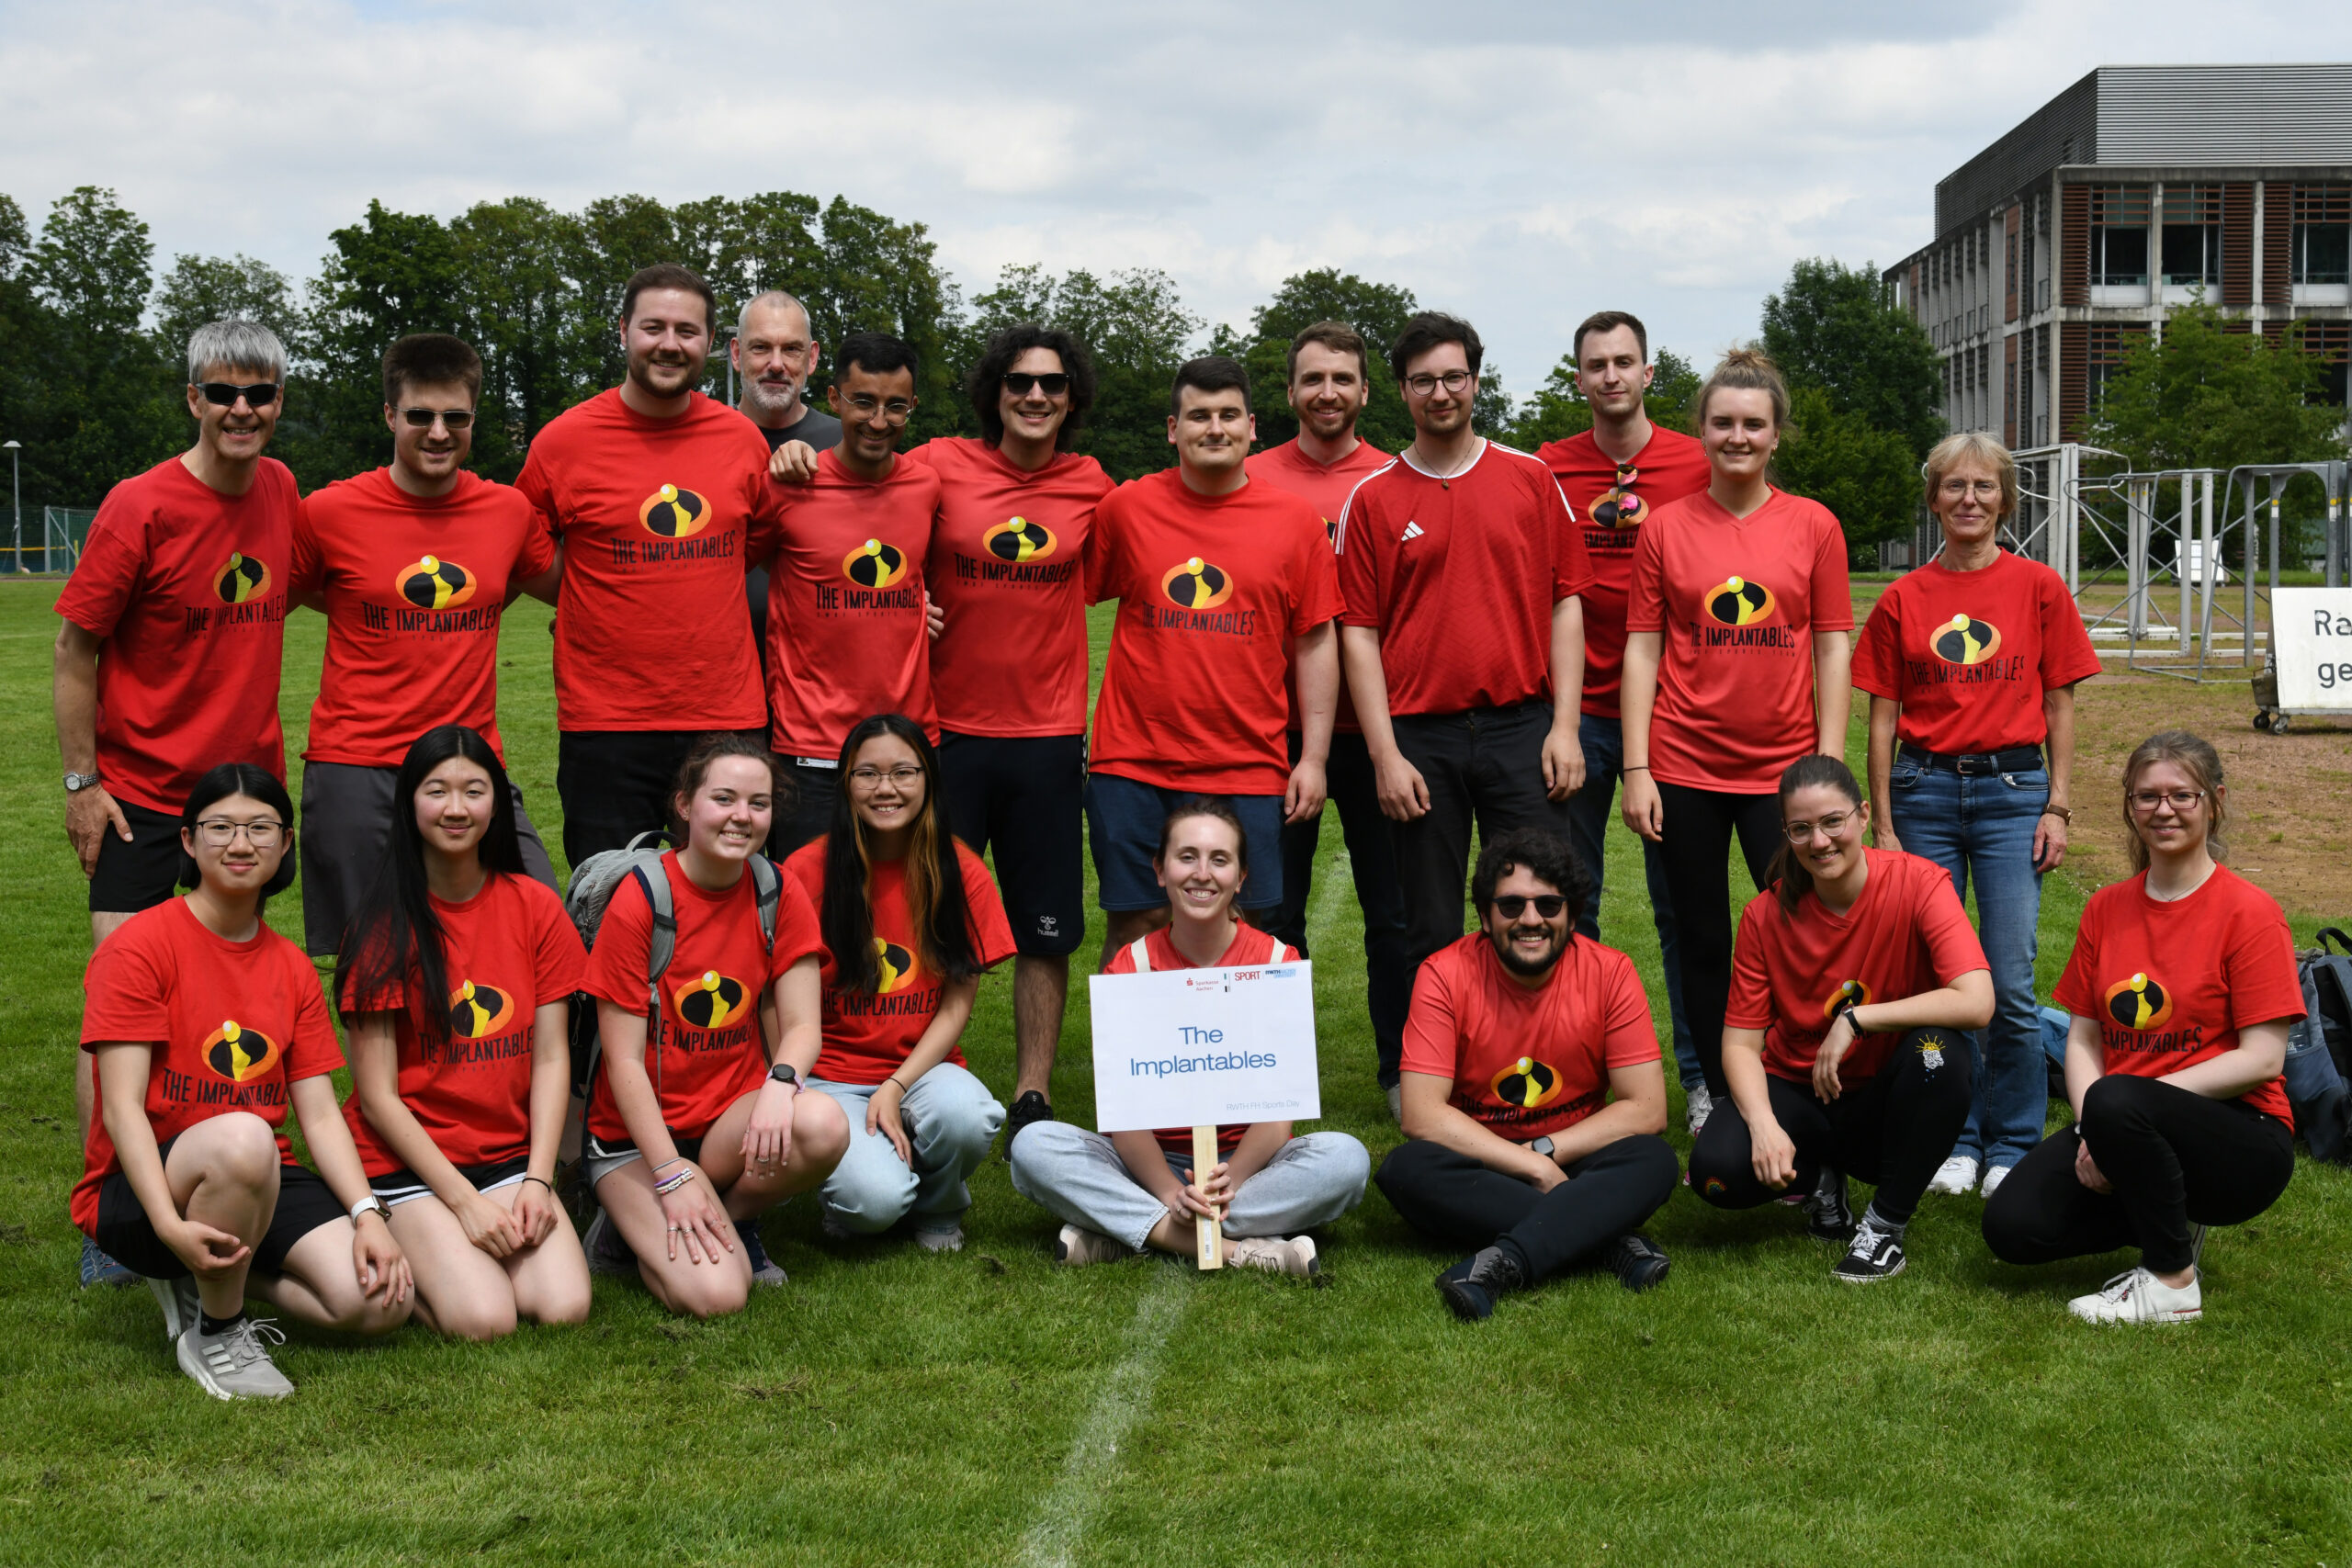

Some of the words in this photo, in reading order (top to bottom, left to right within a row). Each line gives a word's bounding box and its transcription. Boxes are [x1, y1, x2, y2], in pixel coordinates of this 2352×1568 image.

[611, 537, 638, 565] THE
[642, 530, 736, 563] IMPLANTABLES
[955, 552, 978, 580] THE
[981, 558, 1076, 582] IMPLANTABLES
[816, 583, 839, 610] THE
[186, 606, 209, 633] THE
[361, 601, 390, 631] THE
[396, 602, 501, 633] IMPLANTABLES
[1159, 608, 1256, 637] IMPLANTABLES
[1705, 624, 1795, 649] IMPLANTABLES
[1908, 660, 1931, 685] THE
[2318, 663, 2352, 689] ge
[1235, 971, 1261, 981] SPORT
[443, 1025, 534, 1065] IMPLANTABLE
[1178, 1026, 1224, 1044] The
[2109, 1025, 2202, 1054] MPLANTABLES
[1130, 1050, 1277, 1078] Implantables
[161, 1066, 193, 1103] THE
[1227, 1101, 1250, 1111] RWTH
